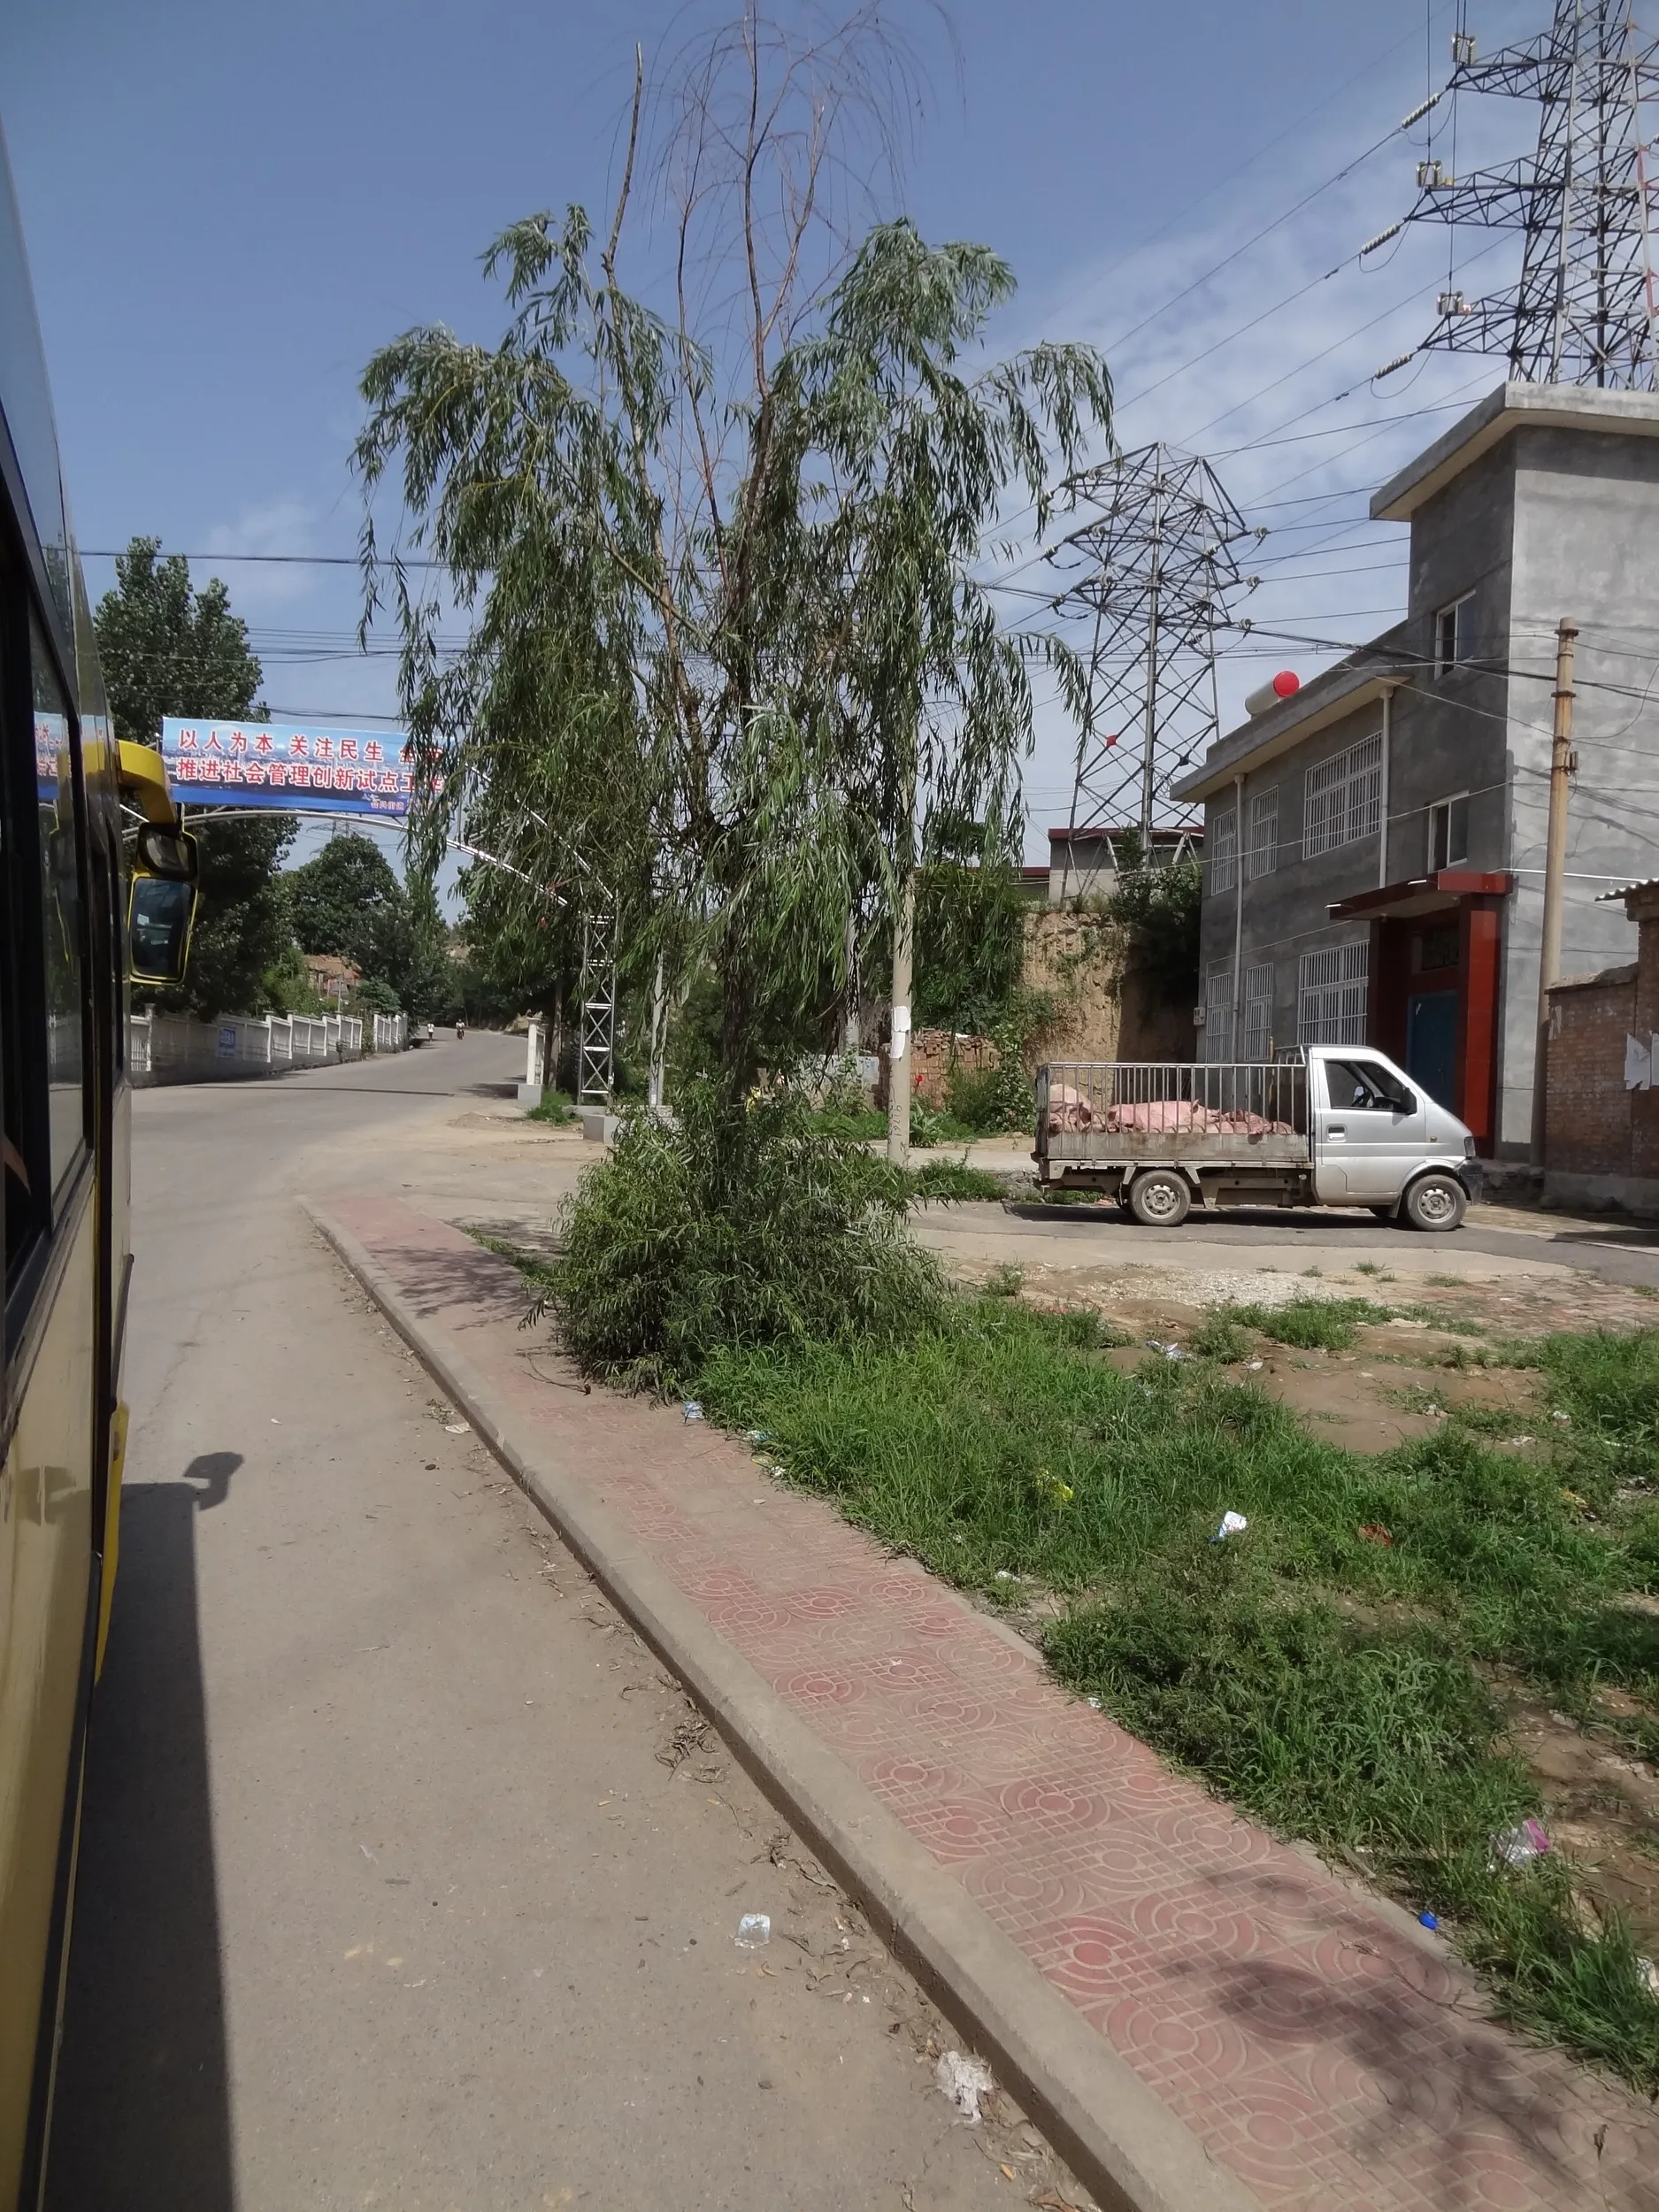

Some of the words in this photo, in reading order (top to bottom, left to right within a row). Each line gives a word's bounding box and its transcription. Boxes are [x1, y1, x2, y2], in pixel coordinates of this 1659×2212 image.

[179, 728, 273, 753] 以人为本
[289, 734, 384, 763] 关注民生
